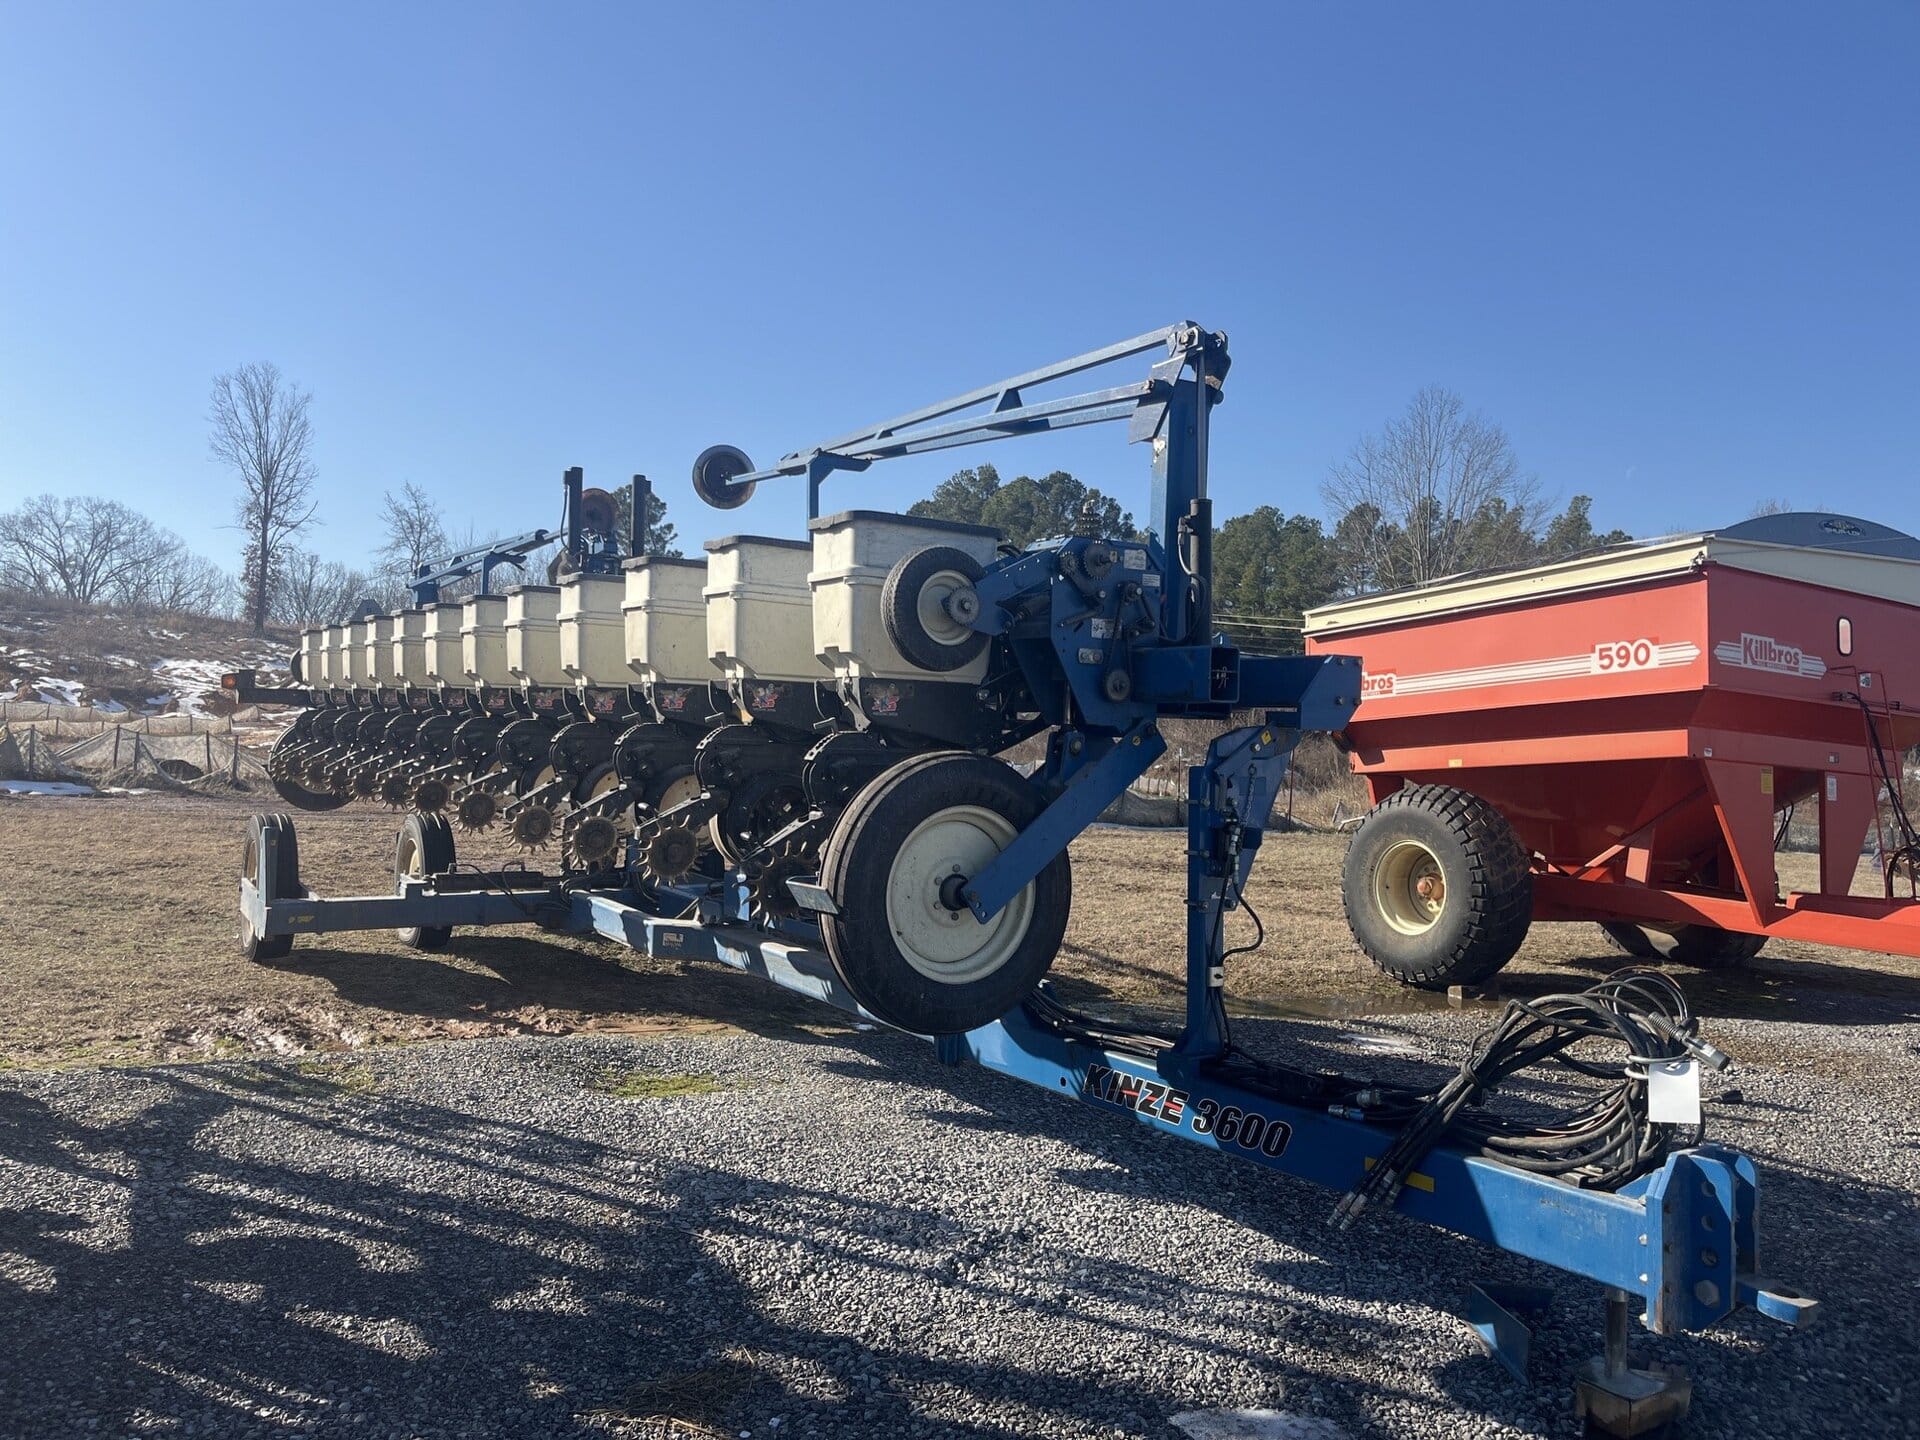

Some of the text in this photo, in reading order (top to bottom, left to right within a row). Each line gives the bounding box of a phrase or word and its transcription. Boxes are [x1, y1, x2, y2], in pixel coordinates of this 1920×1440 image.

[1598, 642, 1651, 670] 590
[1743, 637, 1800, 666] Killbros
[1084, 1063, 1292, 1158] KINZE 3600
